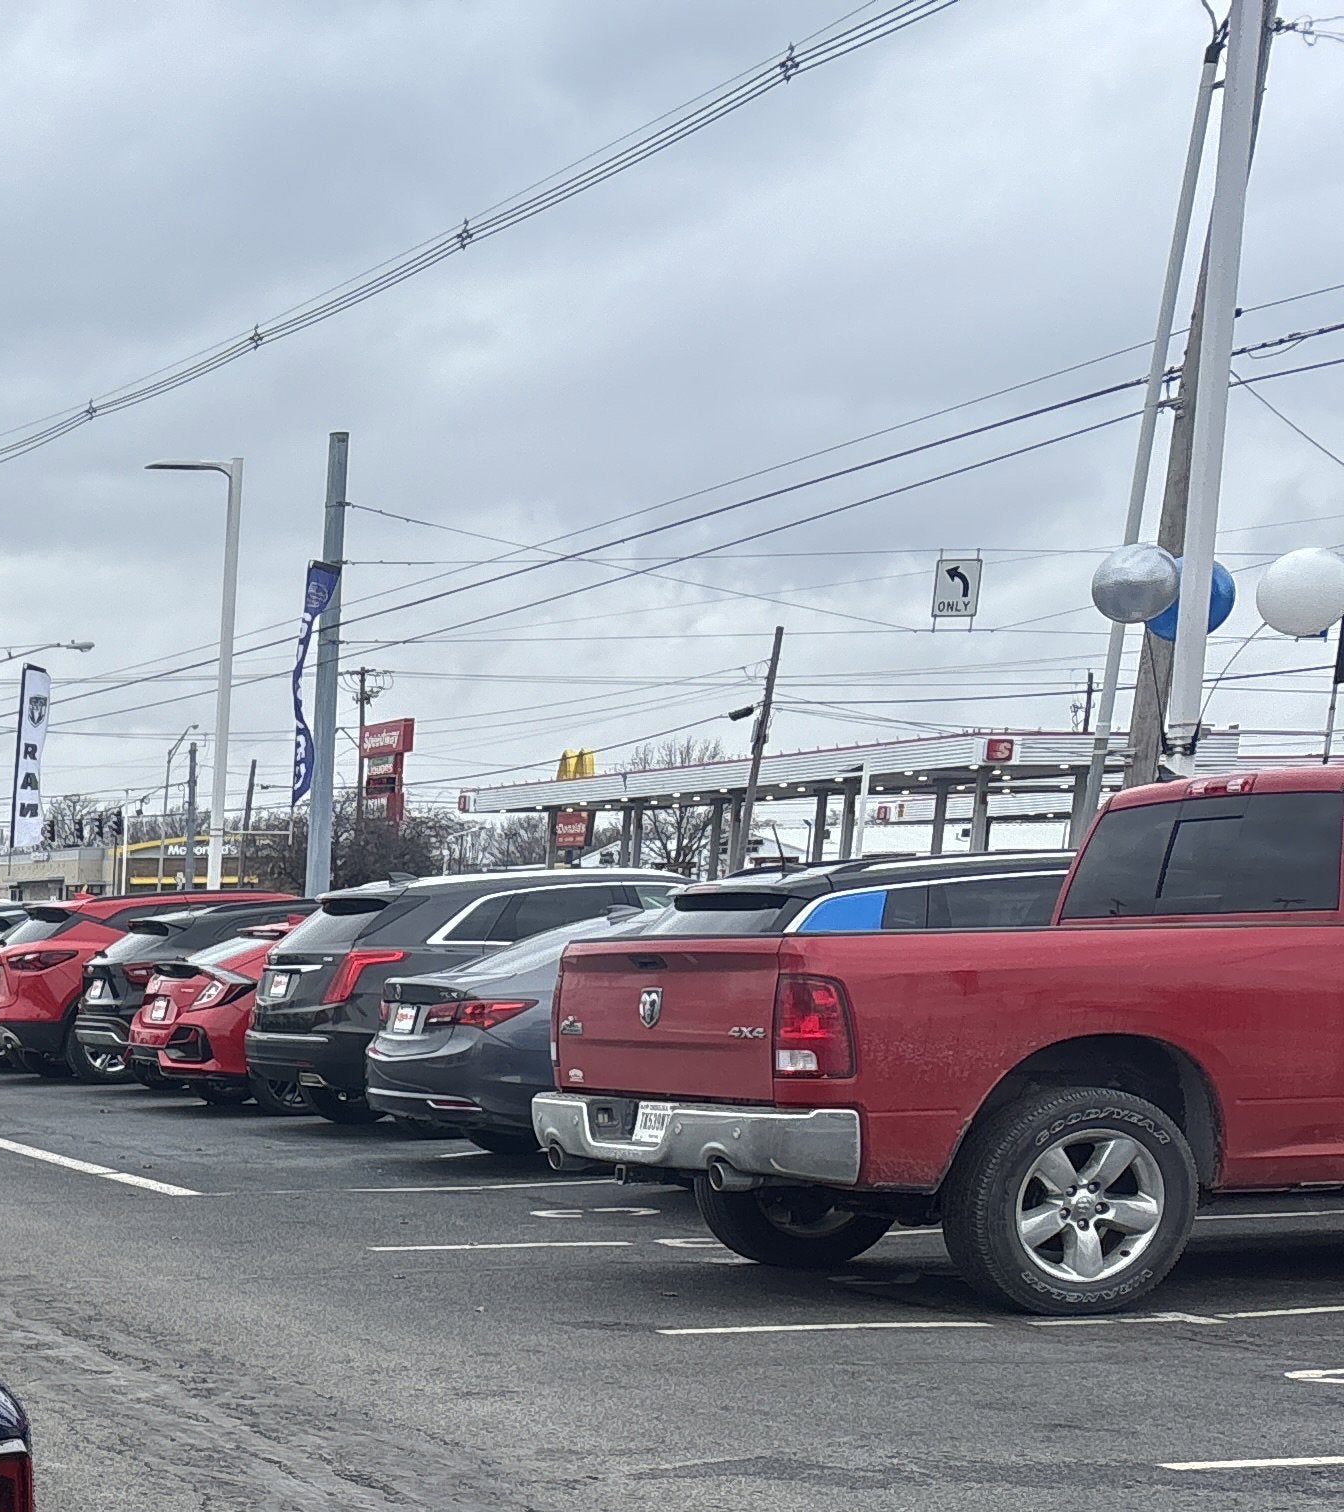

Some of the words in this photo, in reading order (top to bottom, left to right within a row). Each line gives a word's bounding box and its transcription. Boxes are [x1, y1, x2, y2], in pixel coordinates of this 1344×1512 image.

[937, 600, 971, 613] ONLY
[364, 729, 400, 752] Speedway
[1034, 1107, 1171, 1146] GOODYEAR
[1021, 1269, 1153, 1303] WRANGLER
